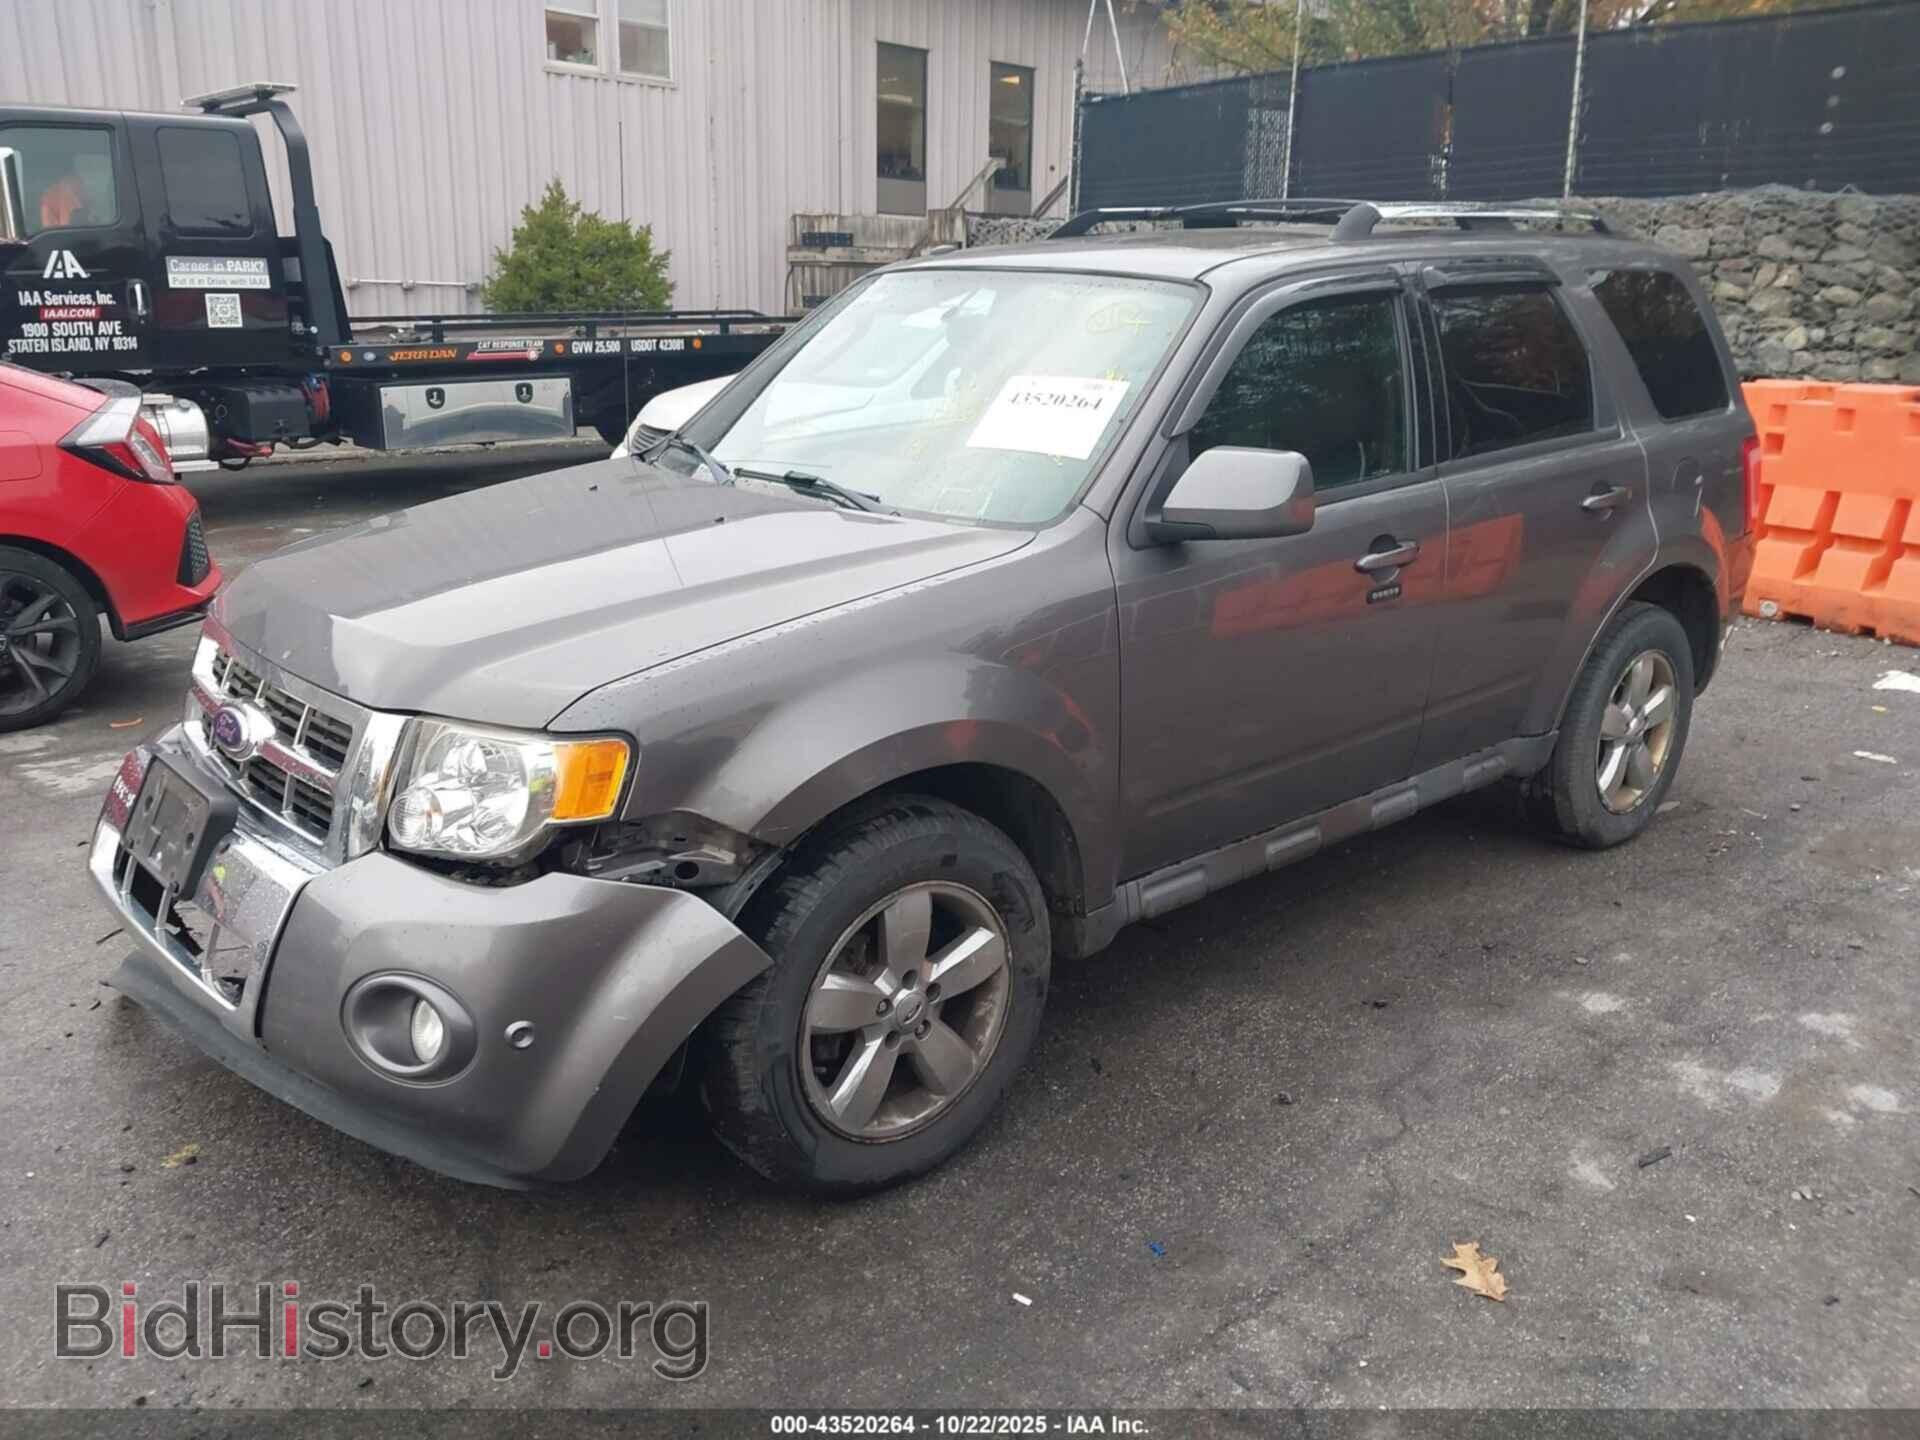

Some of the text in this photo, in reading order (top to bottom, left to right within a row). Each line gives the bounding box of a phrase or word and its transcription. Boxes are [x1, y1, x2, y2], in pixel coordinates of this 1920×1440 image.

[170, 259, 265, 273] Career in PARK?
[18, 290, 116, 306] IAA Services, Inc.
[43, 308, 97, 319] IAAI.COM
[21, 320, 123, 338] 1900 SOUTH AVE
[7, 335, 138, 354] STATEN ISLAND, NY 10314
[571, 340, 594, 354] GVW
[630, 339, 658, 352] USDOT
